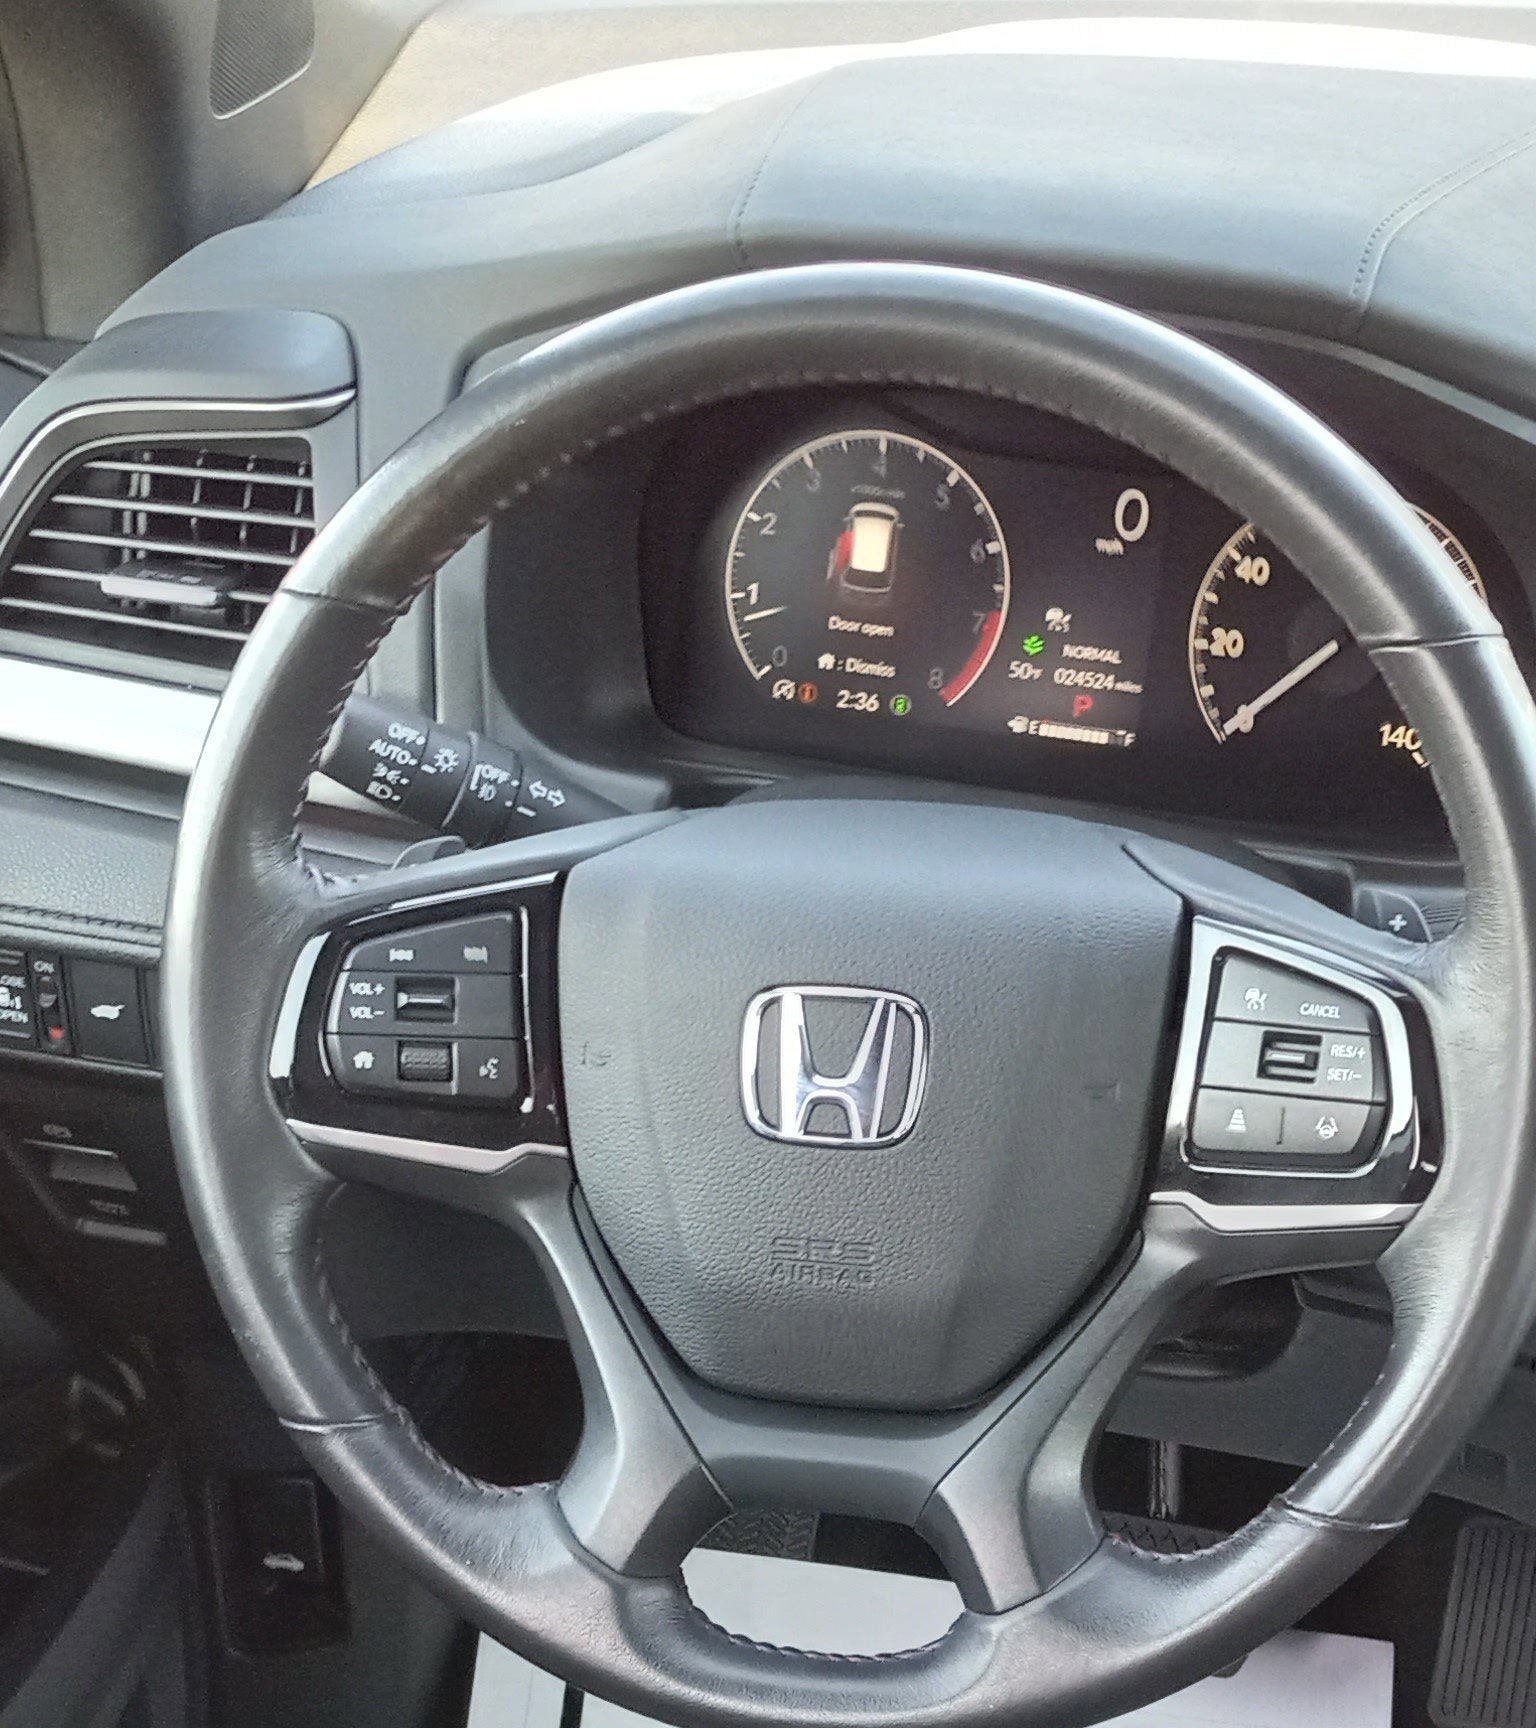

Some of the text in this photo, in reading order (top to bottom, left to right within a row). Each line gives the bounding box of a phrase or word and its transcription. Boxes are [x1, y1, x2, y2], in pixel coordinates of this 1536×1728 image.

[759, 512, 779, 535] 2
[1115, 488, 1149, 542] 0
[1235, 555, 1270, 586] 40
[746, 582, 760, 605] 1
[828, 615, 895, 637] Door open
[1062, 644, 1122, 665] NORMAL
[1209, 627, 1244, 659] 20
[1054, 668, 1116, 691] 024524
[836, 690, 880, 713] 2:36
[1073, 694, 1093, 717] P
[387, 722, 420, 743] OFF
[368, 738, 410, 765] AUTO
[34, 960, 54, 974] ON
[1299, 1003, 1341, 1018] CANCEL
